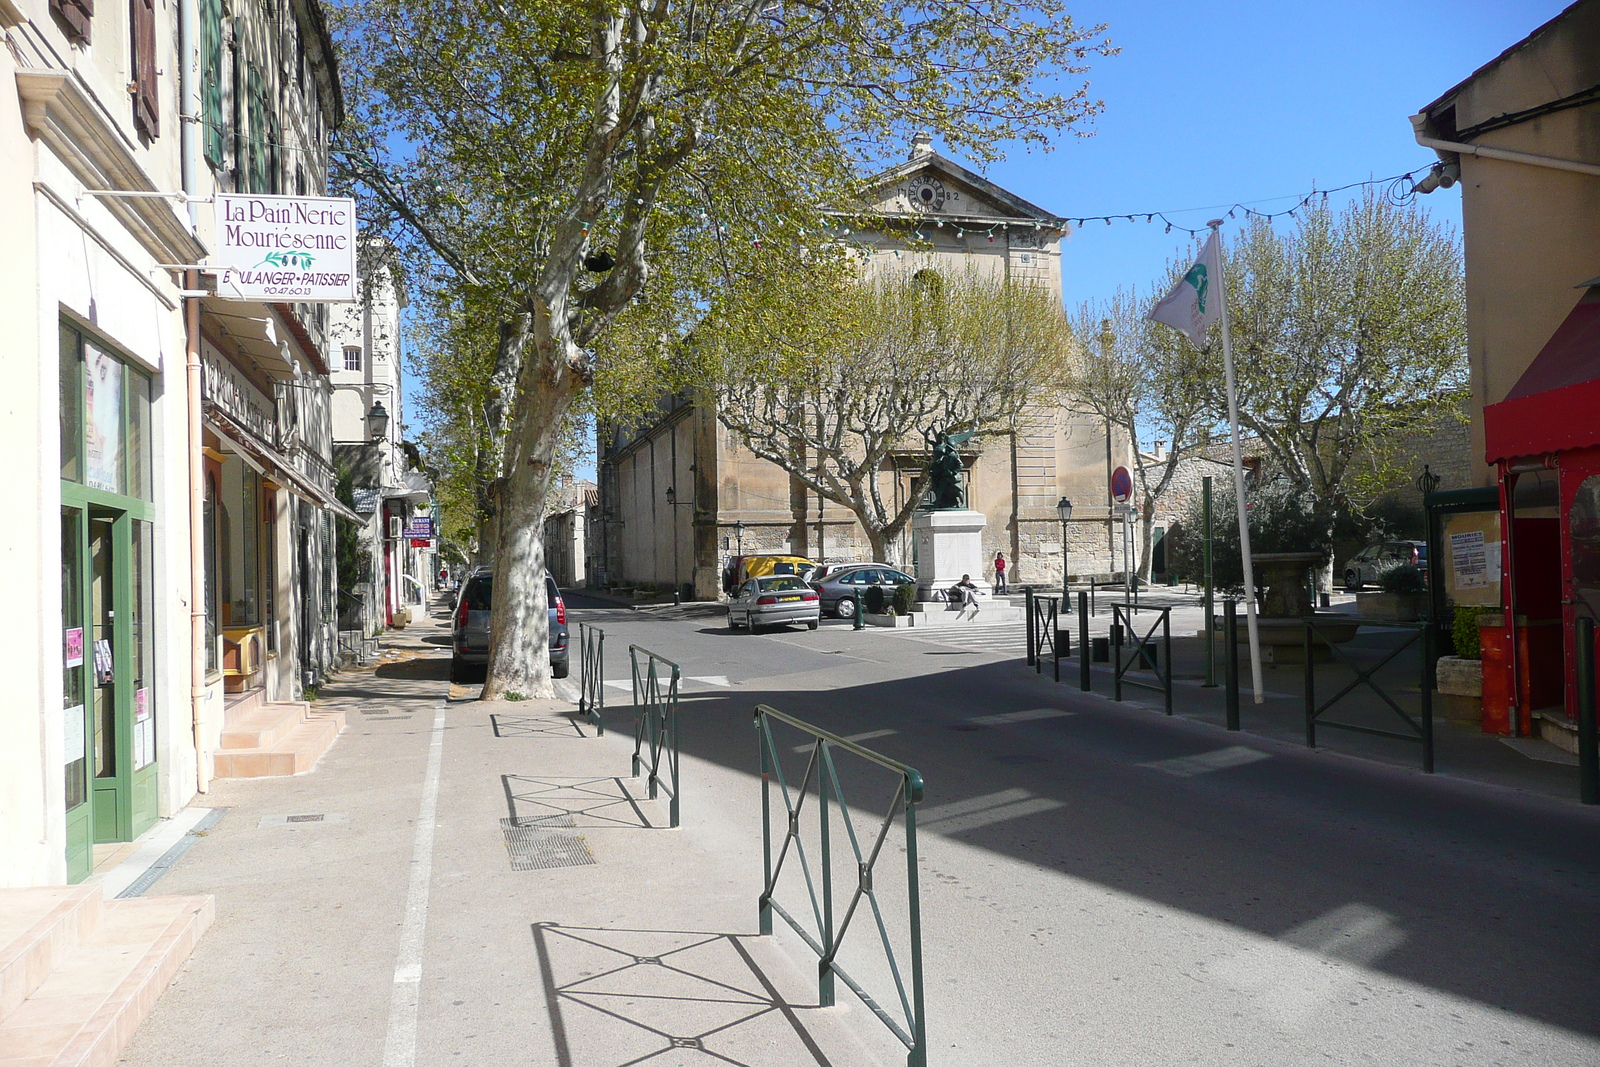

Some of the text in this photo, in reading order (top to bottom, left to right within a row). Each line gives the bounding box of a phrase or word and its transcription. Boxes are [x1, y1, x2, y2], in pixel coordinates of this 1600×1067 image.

[946, 191, 959, 200] 82
[225, 199, 346, 225] La Pain'Nerie
[225, 225, 347, 250] Mouriésenne
[222, 270, 351, 287] BULANGER PATISSIER
[263, 287, 312, 296] 90.47.60.13
